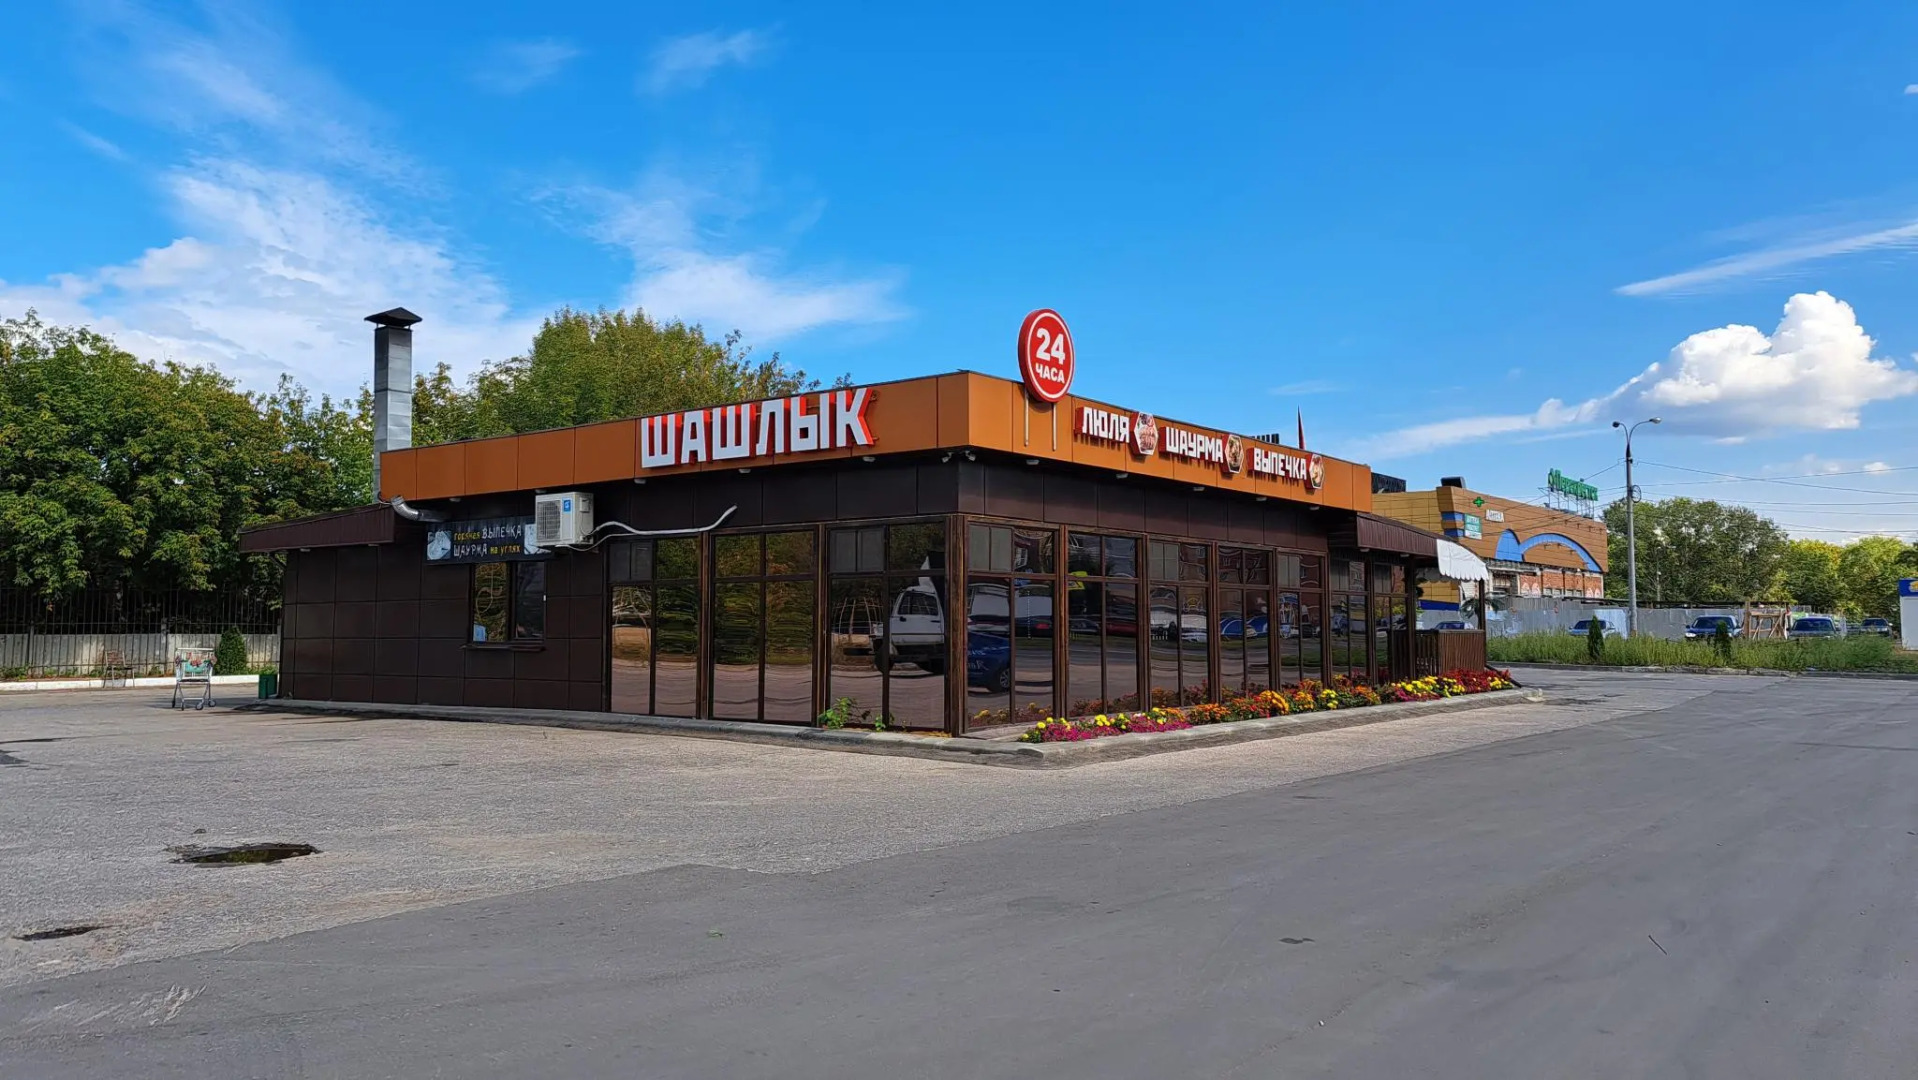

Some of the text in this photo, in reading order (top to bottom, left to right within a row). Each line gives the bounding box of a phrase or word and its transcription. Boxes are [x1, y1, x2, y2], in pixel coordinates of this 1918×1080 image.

[1036, 327, 1065, 365] 24
[1035, 362, 1065, 384] ЧАСА
[641, 388, 873, 469] ШАШЛЫК
[1082, 406, 1307, 481] ЛЮЛЯ ШАУРМА ВЫПЕЧКА
[482, 525, 522, 539] ВЫПЕЧКА
[453, 543, 488, 558] ШАУРМА
